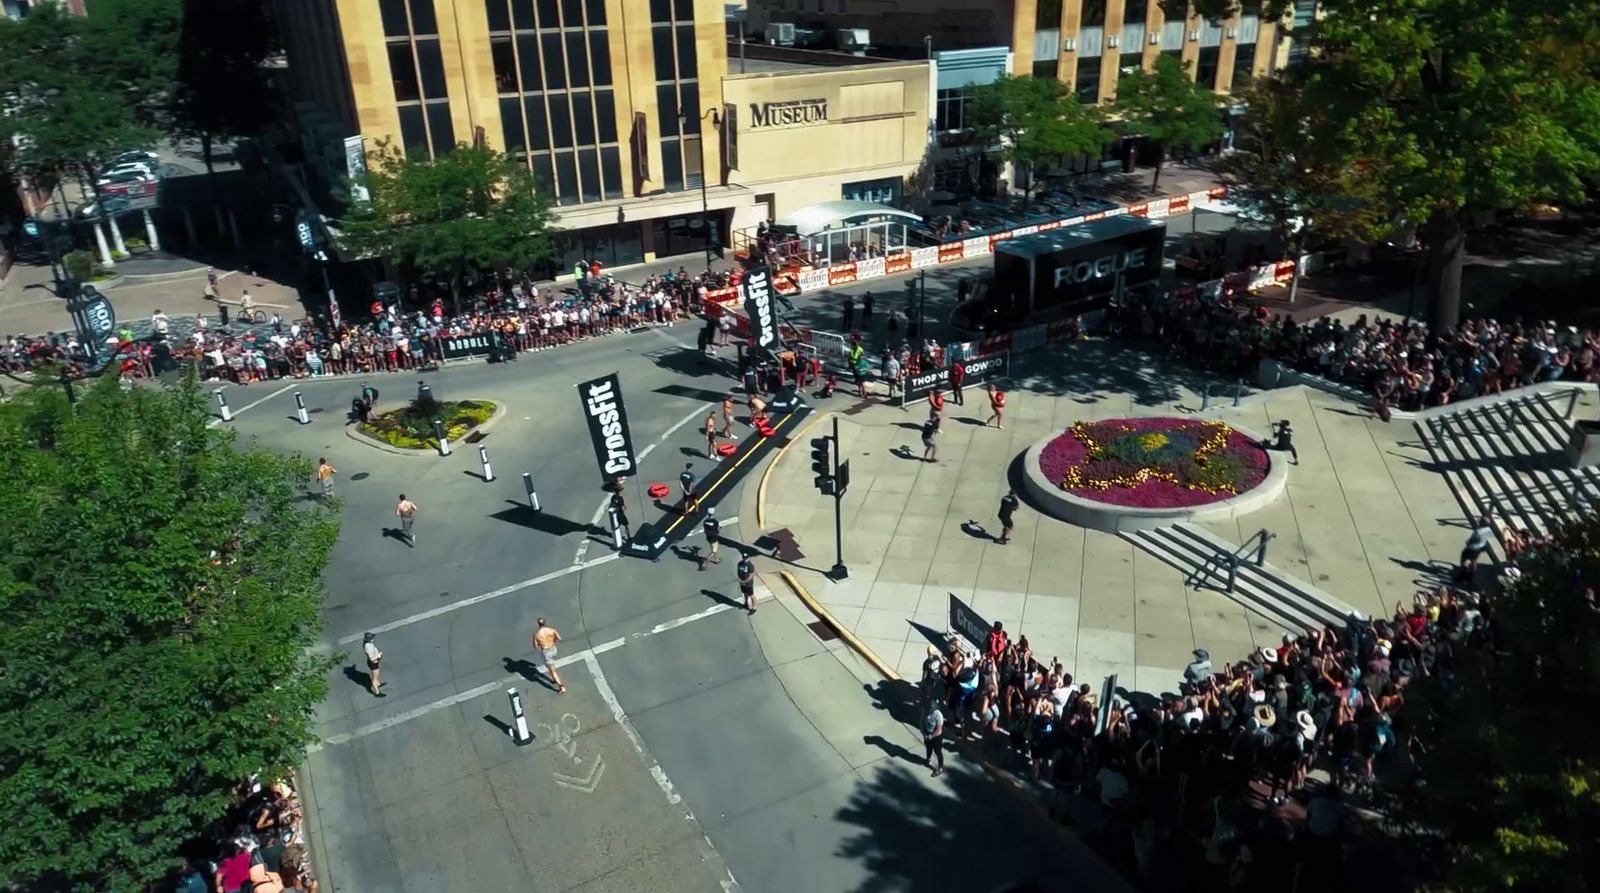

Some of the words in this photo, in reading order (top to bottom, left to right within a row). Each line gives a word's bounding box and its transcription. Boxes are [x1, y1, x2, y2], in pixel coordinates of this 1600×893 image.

[749, 103, 828, 128] MUSEUM
[1054, 247, 1145, 289] ROGUE
[94, 301, 112, 331] 100
[748, 271, 774, 347] CrossFit
[911, 370, 950, 387] THORNE
[587, 381, 631, 474] CrossFit
[957, 608, 988, 643] Cross
